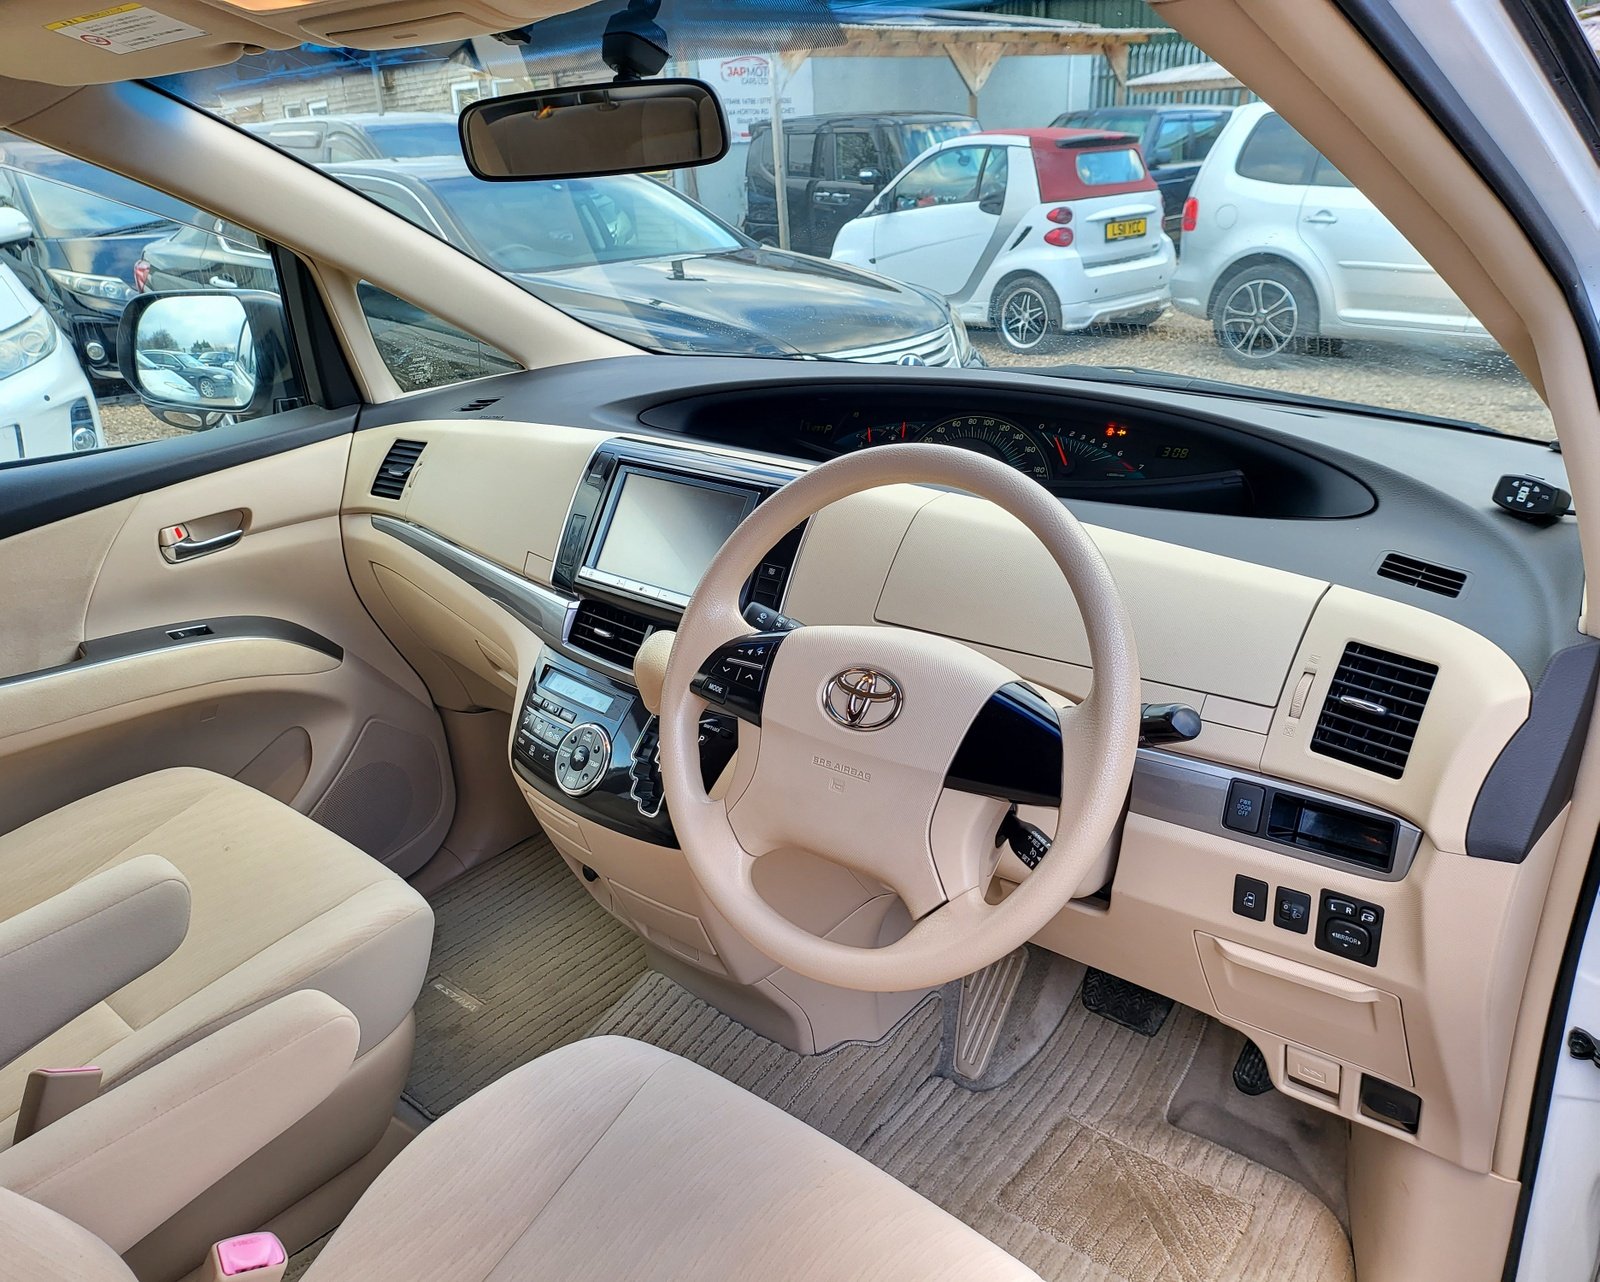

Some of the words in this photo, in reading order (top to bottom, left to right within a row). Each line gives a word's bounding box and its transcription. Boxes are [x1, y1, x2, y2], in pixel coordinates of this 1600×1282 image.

[728, 66, 769, 77] JAPMOT
[999, 424, 1011, 432] 120
[1012, 432, 1024, 441] 140
[1024, 445, 1036, 453] 160
[1033, 465, 1046, 473] 180
[709, 683, 723, 694] MODE
[813, 756, 832, 767] SRS
[833, 763, 872, 780] AIRBAG
[1236, 803, 1252, 812] DOOR
[1237, 809, 1249, 817] OFF
[1330, 903, 1337, 911] L
[1345, 906, 1352, 915] R
[1335, 932, 1358, 945] MIRROR
